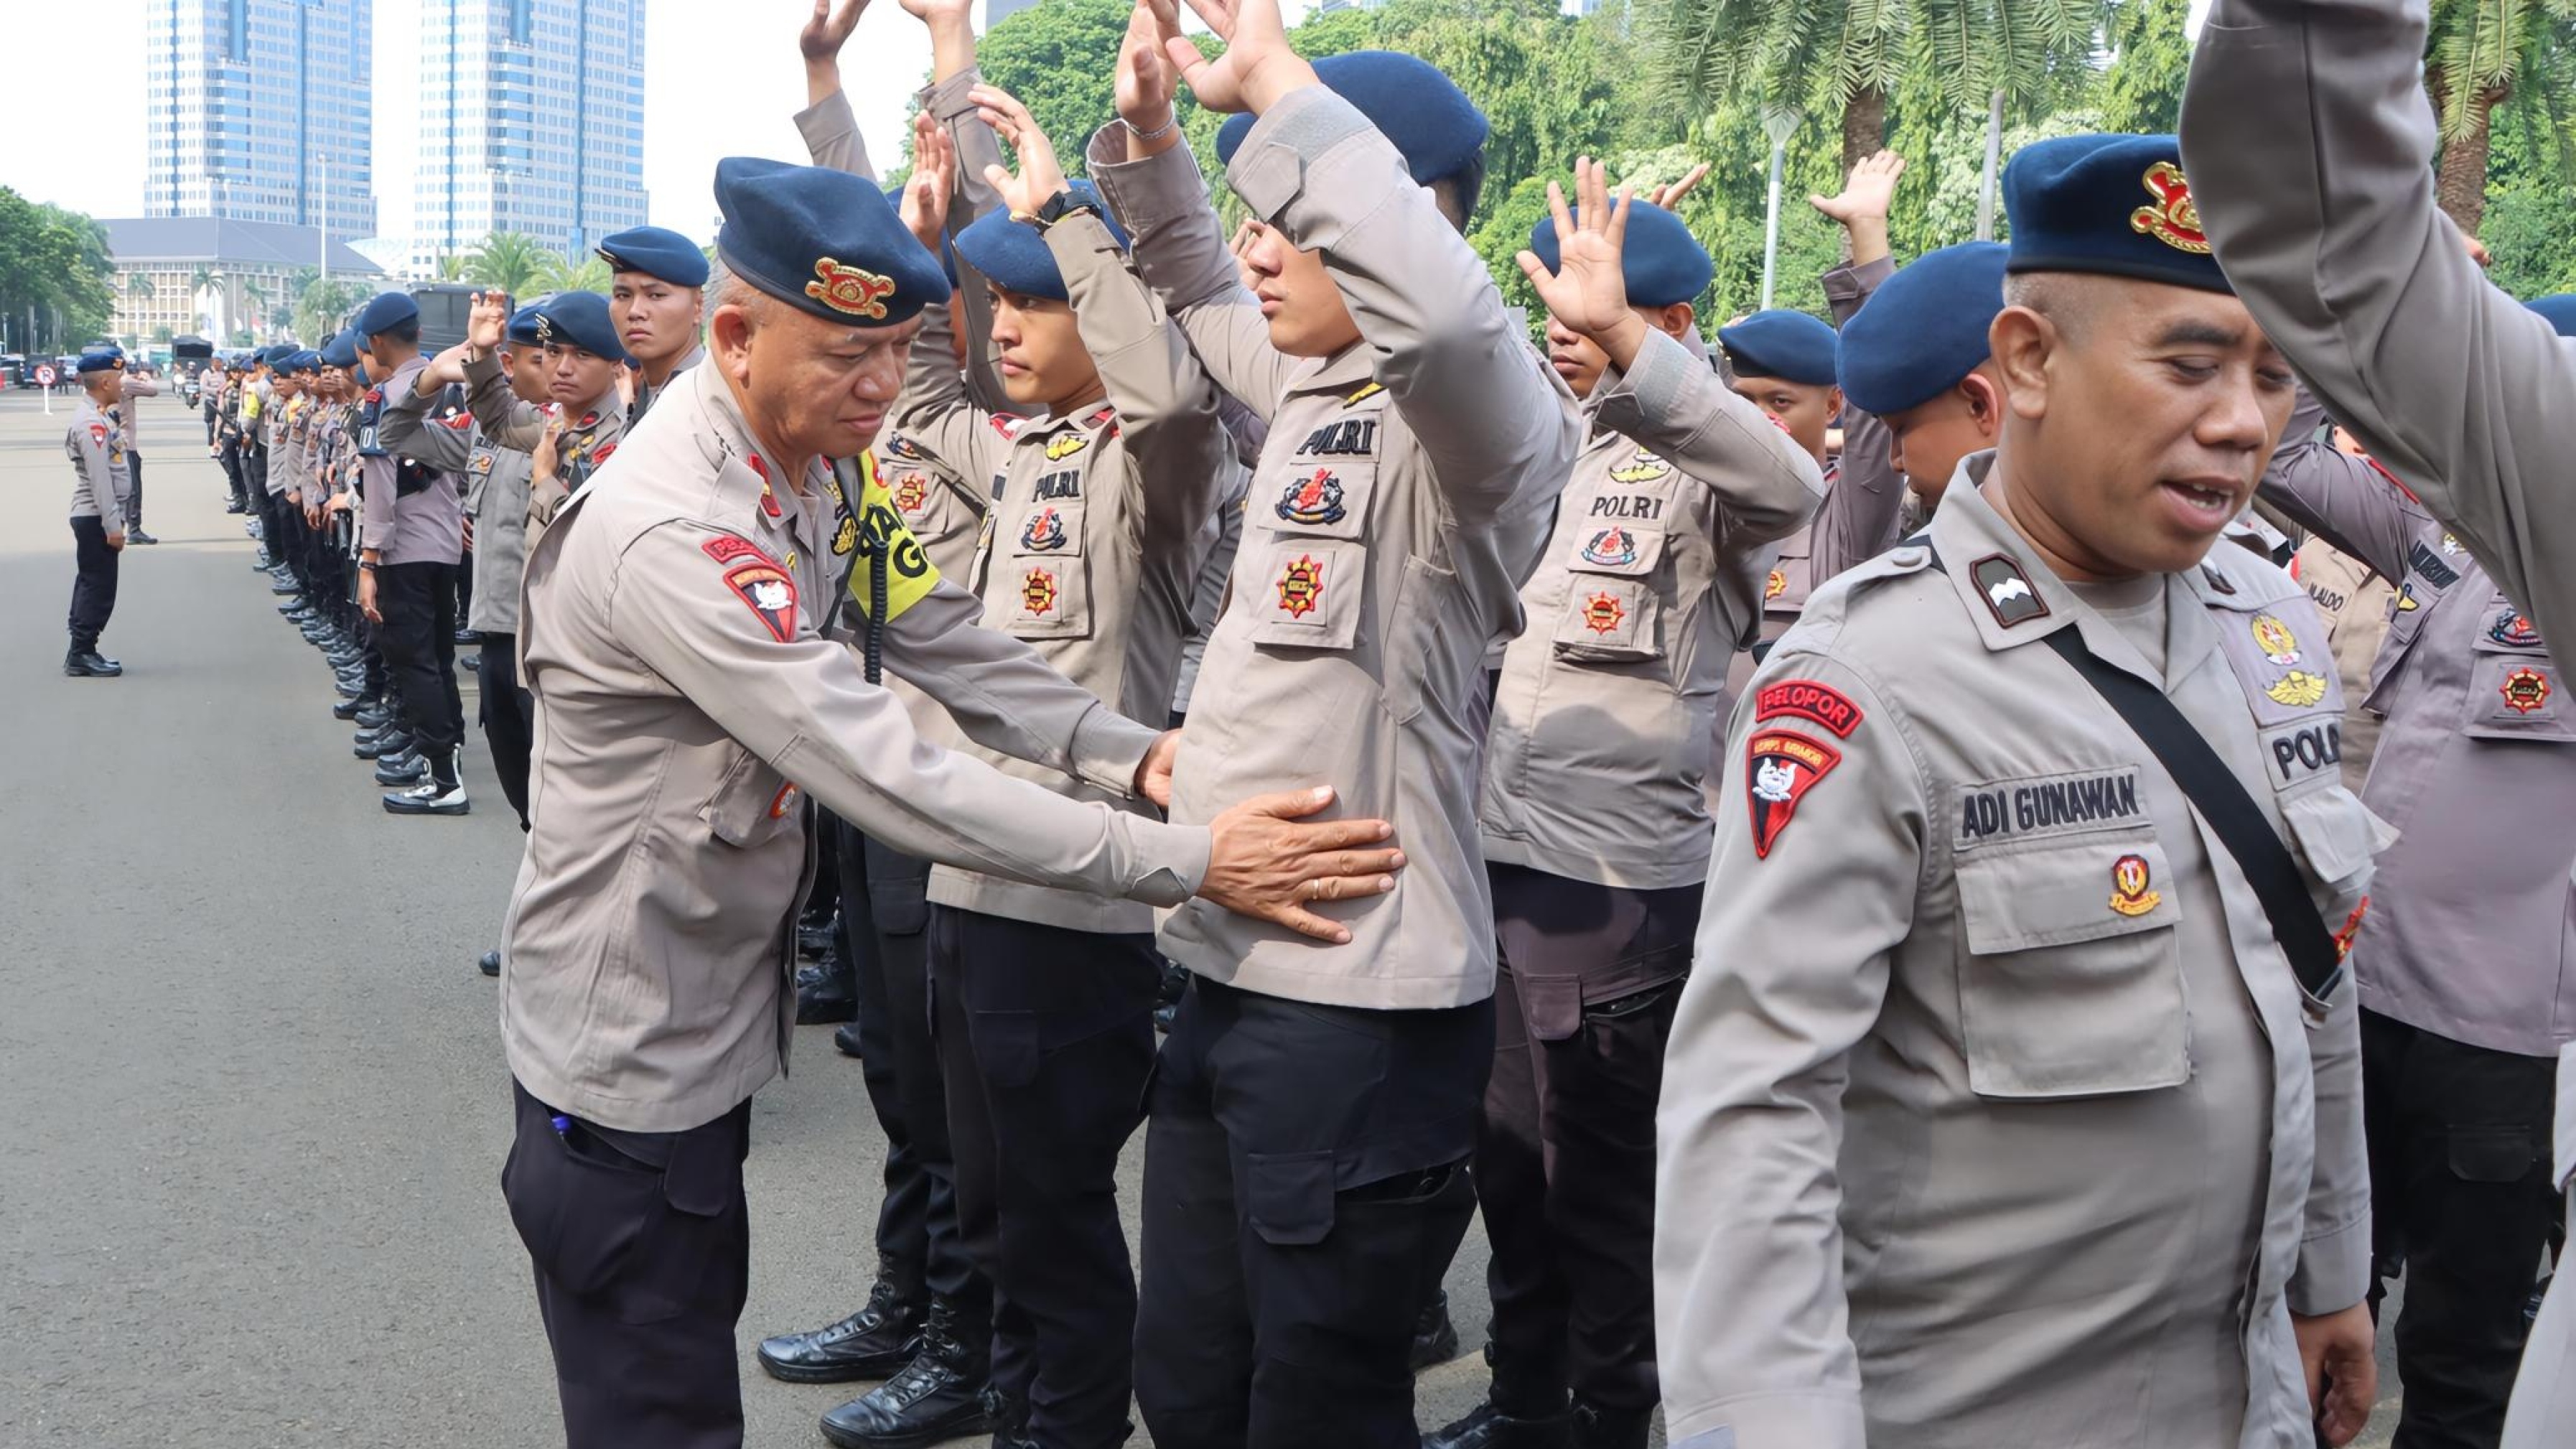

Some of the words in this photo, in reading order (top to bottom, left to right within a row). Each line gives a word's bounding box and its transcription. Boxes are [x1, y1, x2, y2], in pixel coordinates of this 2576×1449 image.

[1296, 419, 1376, 455] POLRI
[1032, 470, 1080, 503] POLRI
[1590, 495, 1662, 519] POLRI
[1764, 687, 1849, 726] PELOPOR
[1962, 791, 2010, 838] ADI
[2015, 774, 2139, 830] GUNAWAN
